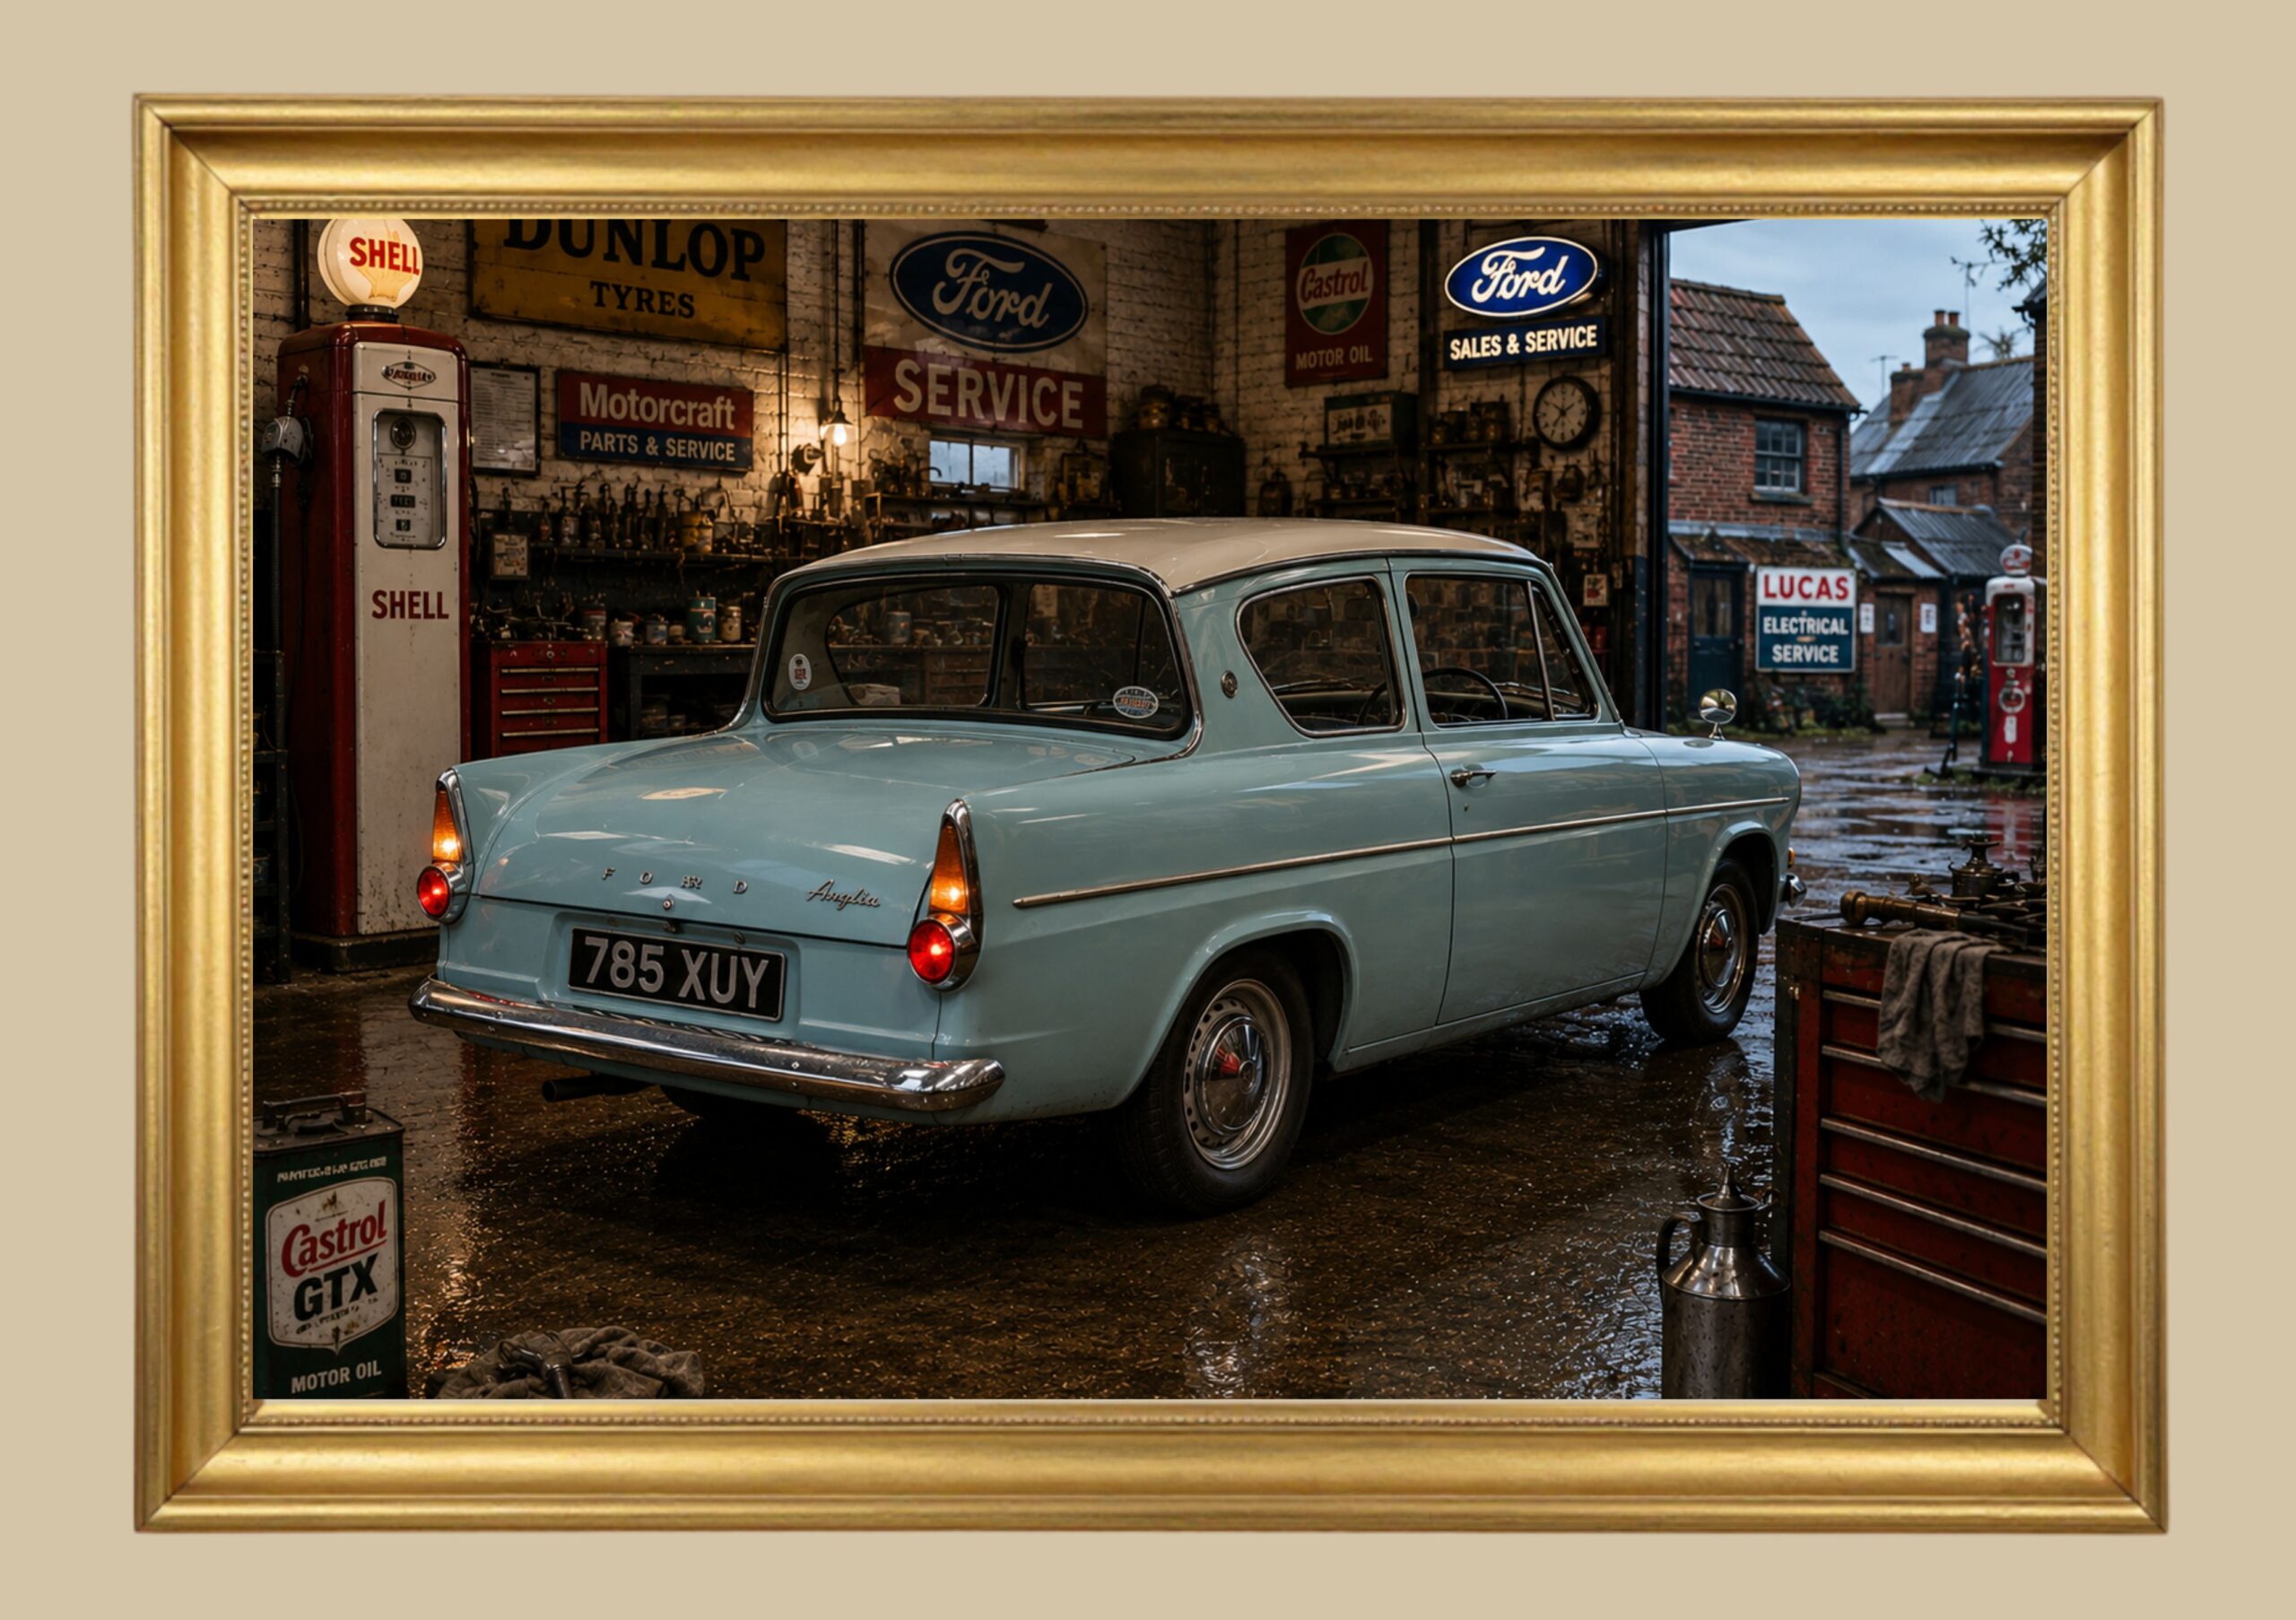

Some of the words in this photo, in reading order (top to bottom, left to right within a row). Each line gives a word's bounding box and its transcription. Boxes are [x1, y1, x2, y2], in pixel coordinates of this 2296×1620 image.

[349, 237, 421, 275] SHELL
[503, 219, 765, 282] DUNLOP
[933, 248, 1054, 329] Ford
[1300, 264, 1368, 303] Castrol
[1472, 247, 1569, 302] Ford
[589, 281, 695, 319] TYRES
[1296, 347, 1344, 370] MOTOR
[1349, 346, 1372, 362] OIL
[1449, 335, 1501, 360] SALES
[1507, 334, 1519, 353] &
[1525, 325, 1596, 352] SERVICE
[579, 382, 735, 431] Motorcraft
[894, 359, 1083, 429] SERVICE
[579, 431, 639, 454] PARTS
[646, 437, 659, 457] &
[665, 440, 735, 462] SERVICE
[371, 589, 449, 620] SHELL
[1764, 575, 1849, 600] LUCAS
[1763, 617, 1848, 635] ELECTRICAL
[1772, 645, 1839, 664] SERVICE
[808, 878, 881, 910] Anglia
[585, 936, 664, 993] 785
[677, 949, 770, 1009] XUY
[281, 1199, 387, 1277] Castrol
[294, 1252, 378, 1322] GTX
[291, 1366, 351, 1394] MOTOR
[355, 1360, 382, 1380] OIL
